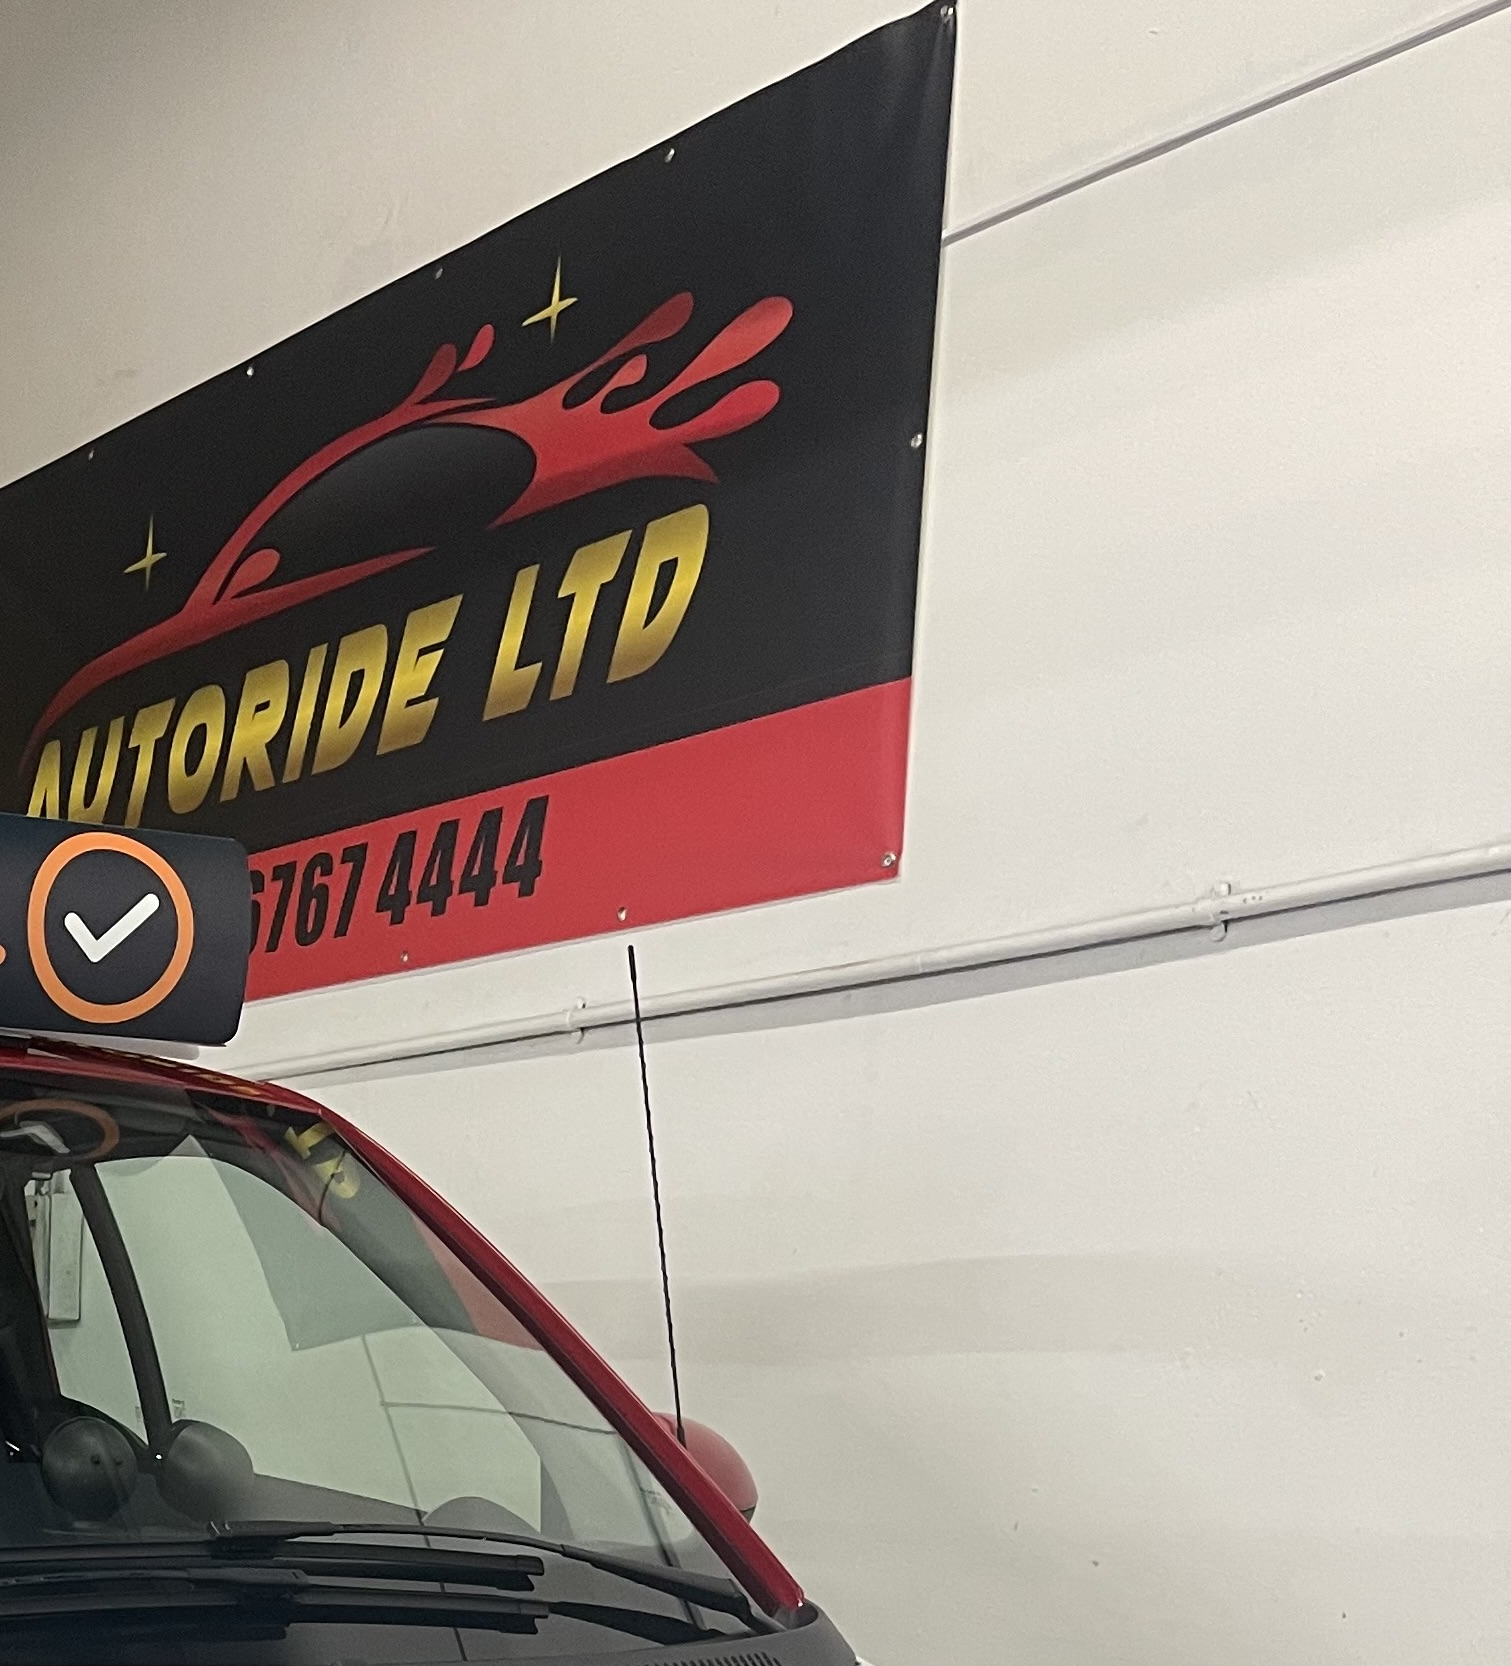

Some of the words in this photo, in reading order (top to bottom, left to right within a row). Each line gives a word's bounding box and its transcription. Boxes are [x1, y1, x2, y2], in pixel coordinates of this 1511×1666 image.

[26, 593, 464, 828] AUTORIDE
[483, 503, 710, 721] LTD
[376, 795, 550, 925] 4444
